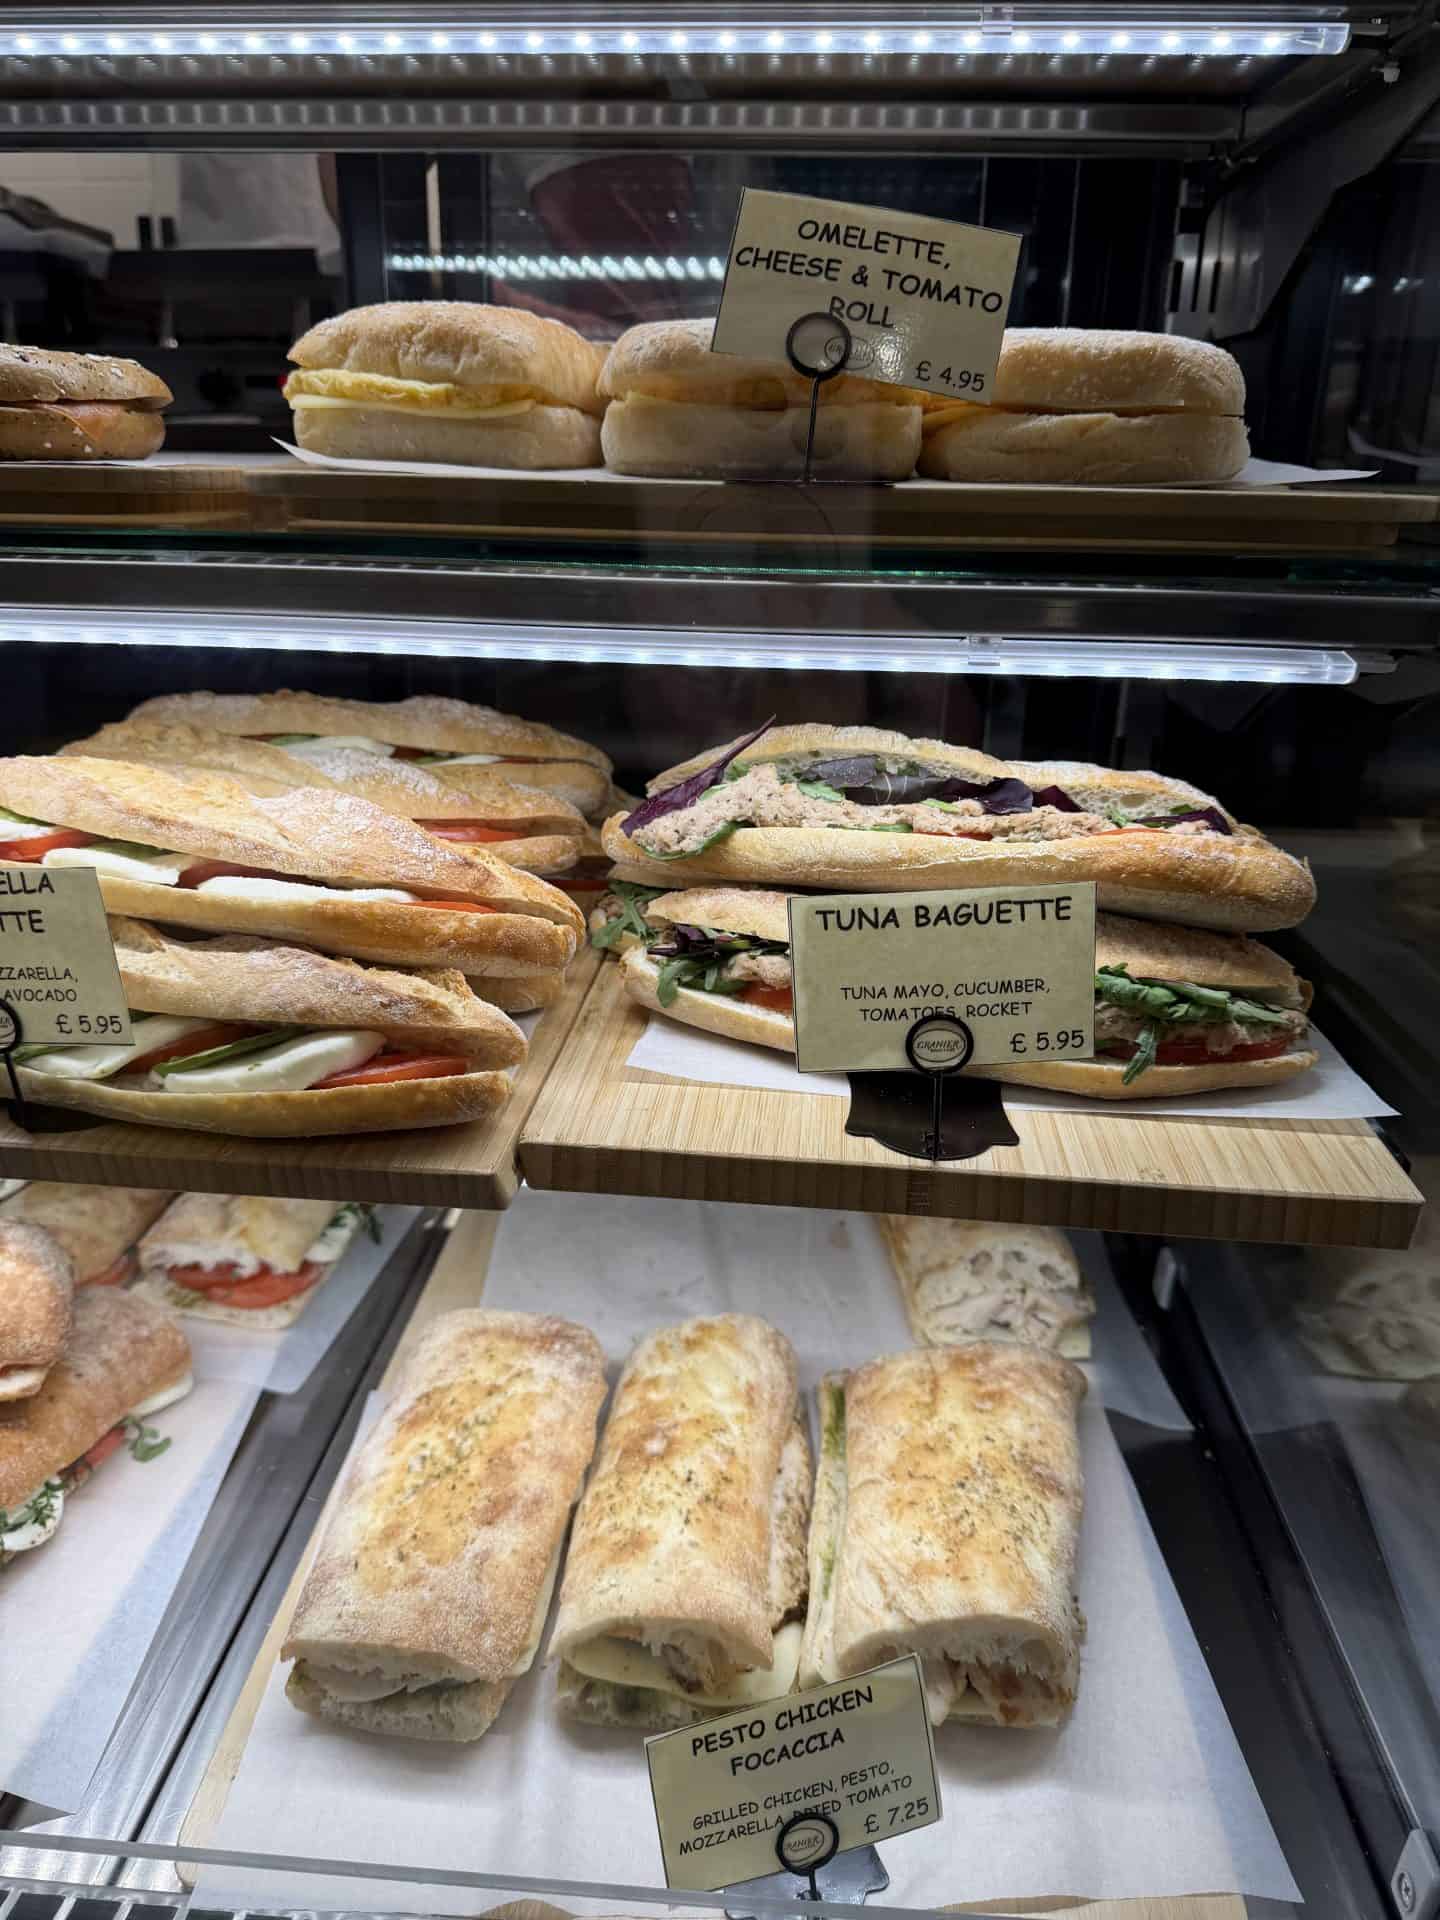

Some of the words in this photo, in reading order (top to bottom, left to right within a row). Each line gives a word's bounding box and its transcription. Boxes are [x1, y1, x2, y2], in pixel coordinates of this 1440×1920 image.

[798, 219, 951, 270] OMELETTE,
[735, 247, 842, 281] CHEESE
[851, 265, 868, 288] &
[882, 269, 1003, 313] TOMATO
[829, 296, 895, 328] ROLL
[915, 360, 931, 382] £
[940, 367, 985, 393] 4.95
[815, 907, 900, 931] TUNA
[914, 896, 1073, 928] BAGUETTE
[4, 988, 77, 1002] AVOCADO
[840, 986, 888, 1001] TUNA
[893, 983, 949, 1000] MAYO,
[954, 978, 1051, 997] CUCUMBER,
[55, 1013, 73, 1035] £
[78, 1015, 123, 1035] 5.95
[966, 1001, 1033, 1018] ROCKET
[1009, 1032, 1027, 1054] £
[1036, 1029, 1085, 1052] 5.95
[691, 1719, 766, 1757] PESTO
[774, 1685, 874, 1732] CHICKEN
[730, 1727, 846, 1777] FOCACCIA
[692, 1801, 759, 1830] GRILLED
[763, 1779, 838, 1810] CHICKEN,
[841, 1760, 895, 1789] PESTO,
[846, 1774, 913, 1807] TOMATO
[863, 1813, 881, 1834] £
[887, 1796, 930, 1828] 7.25
